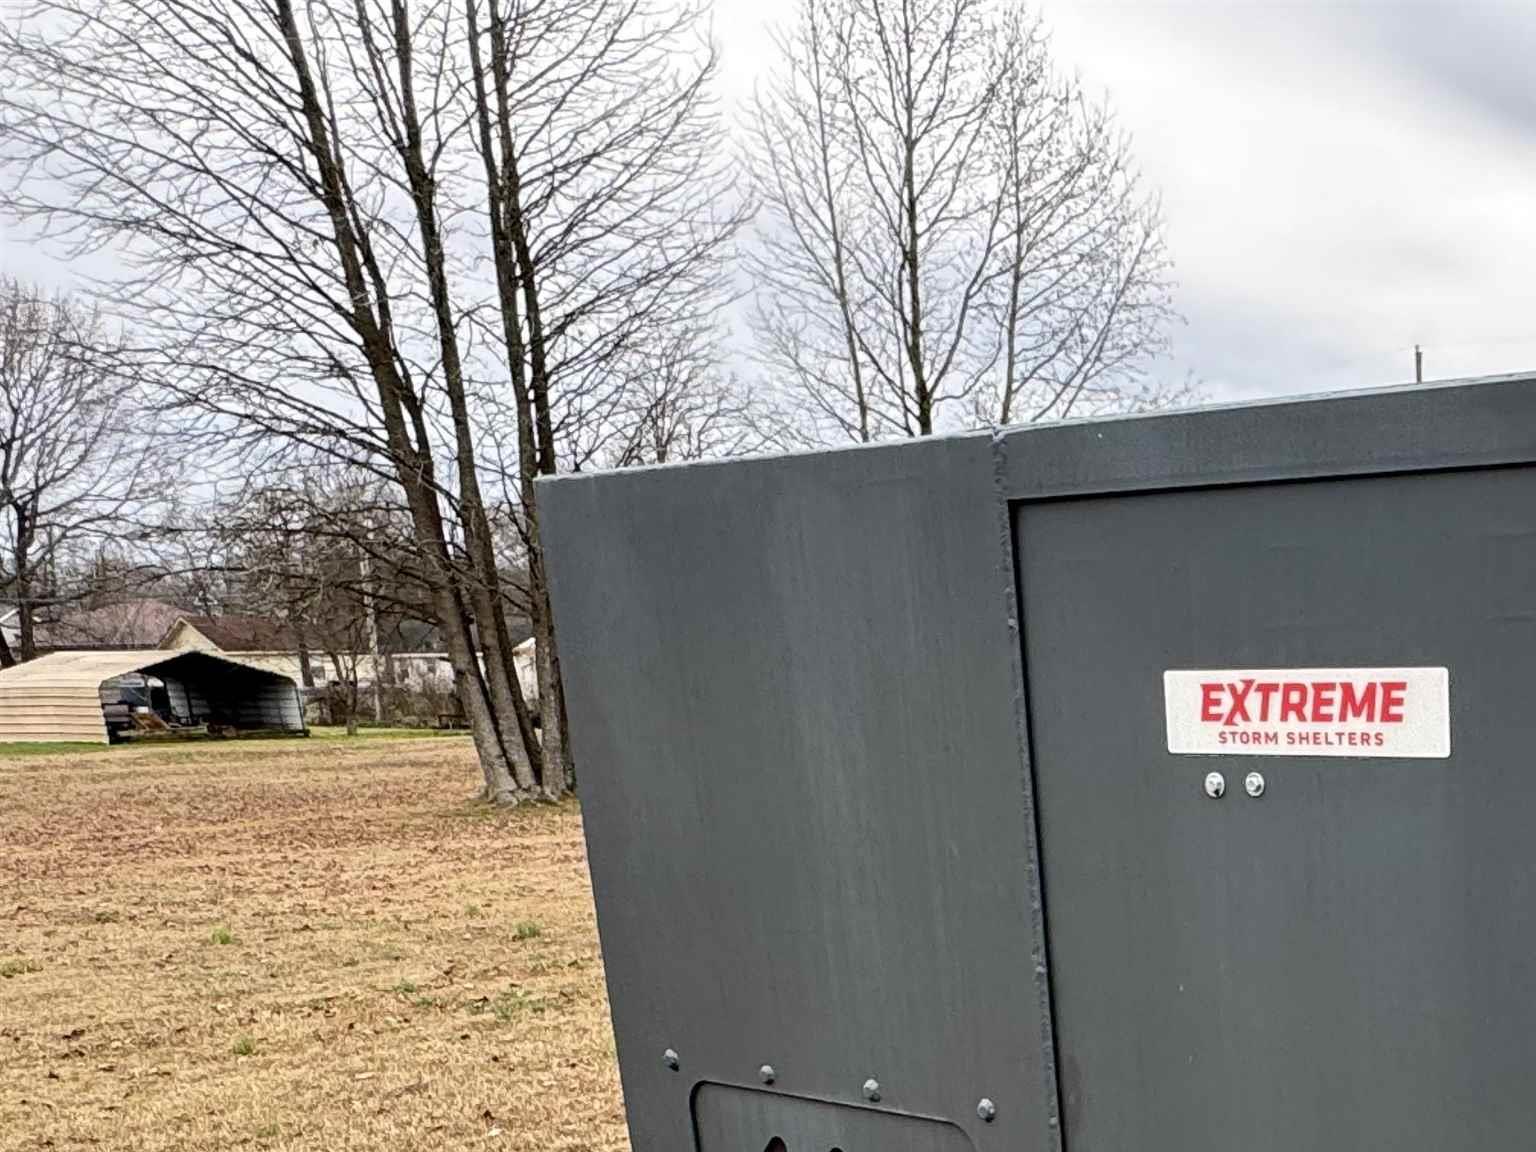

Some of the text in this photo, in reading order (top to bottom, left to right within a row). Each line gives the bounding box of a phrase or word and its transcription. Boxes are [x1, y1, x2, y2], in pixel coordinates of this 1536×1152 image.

[1200, 679, 1407, 726] EXTREME
[1217, 731, 1384, 746] STORM SHELTERS
